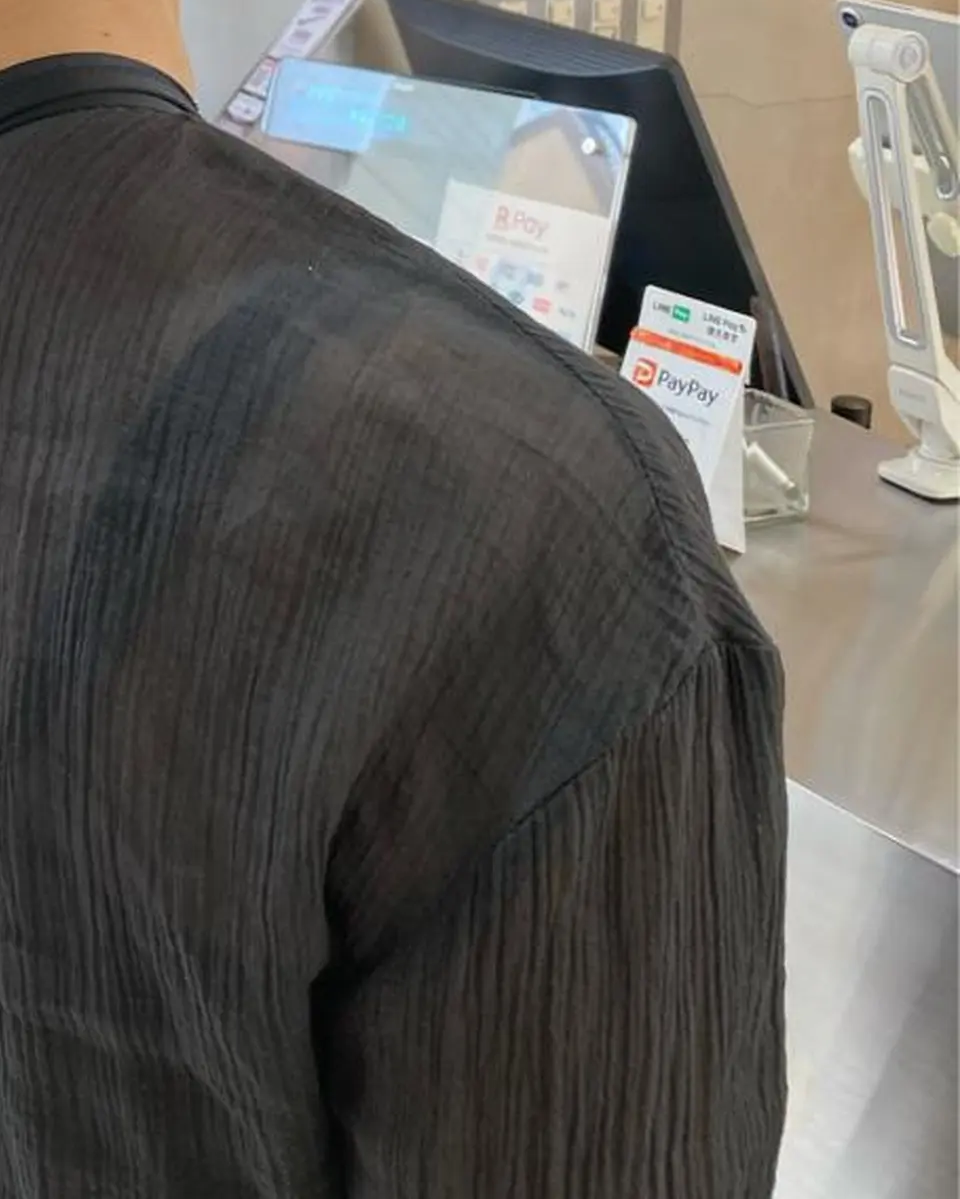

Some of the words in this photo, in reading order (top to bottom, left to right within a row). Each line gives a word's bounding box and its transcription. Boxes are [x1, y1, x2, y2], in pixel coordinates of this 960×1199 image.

[514, 210, 549, 239] Pay
[653, 302, 671, 314] LINE
[658, 369, 720, 407] PayPay
